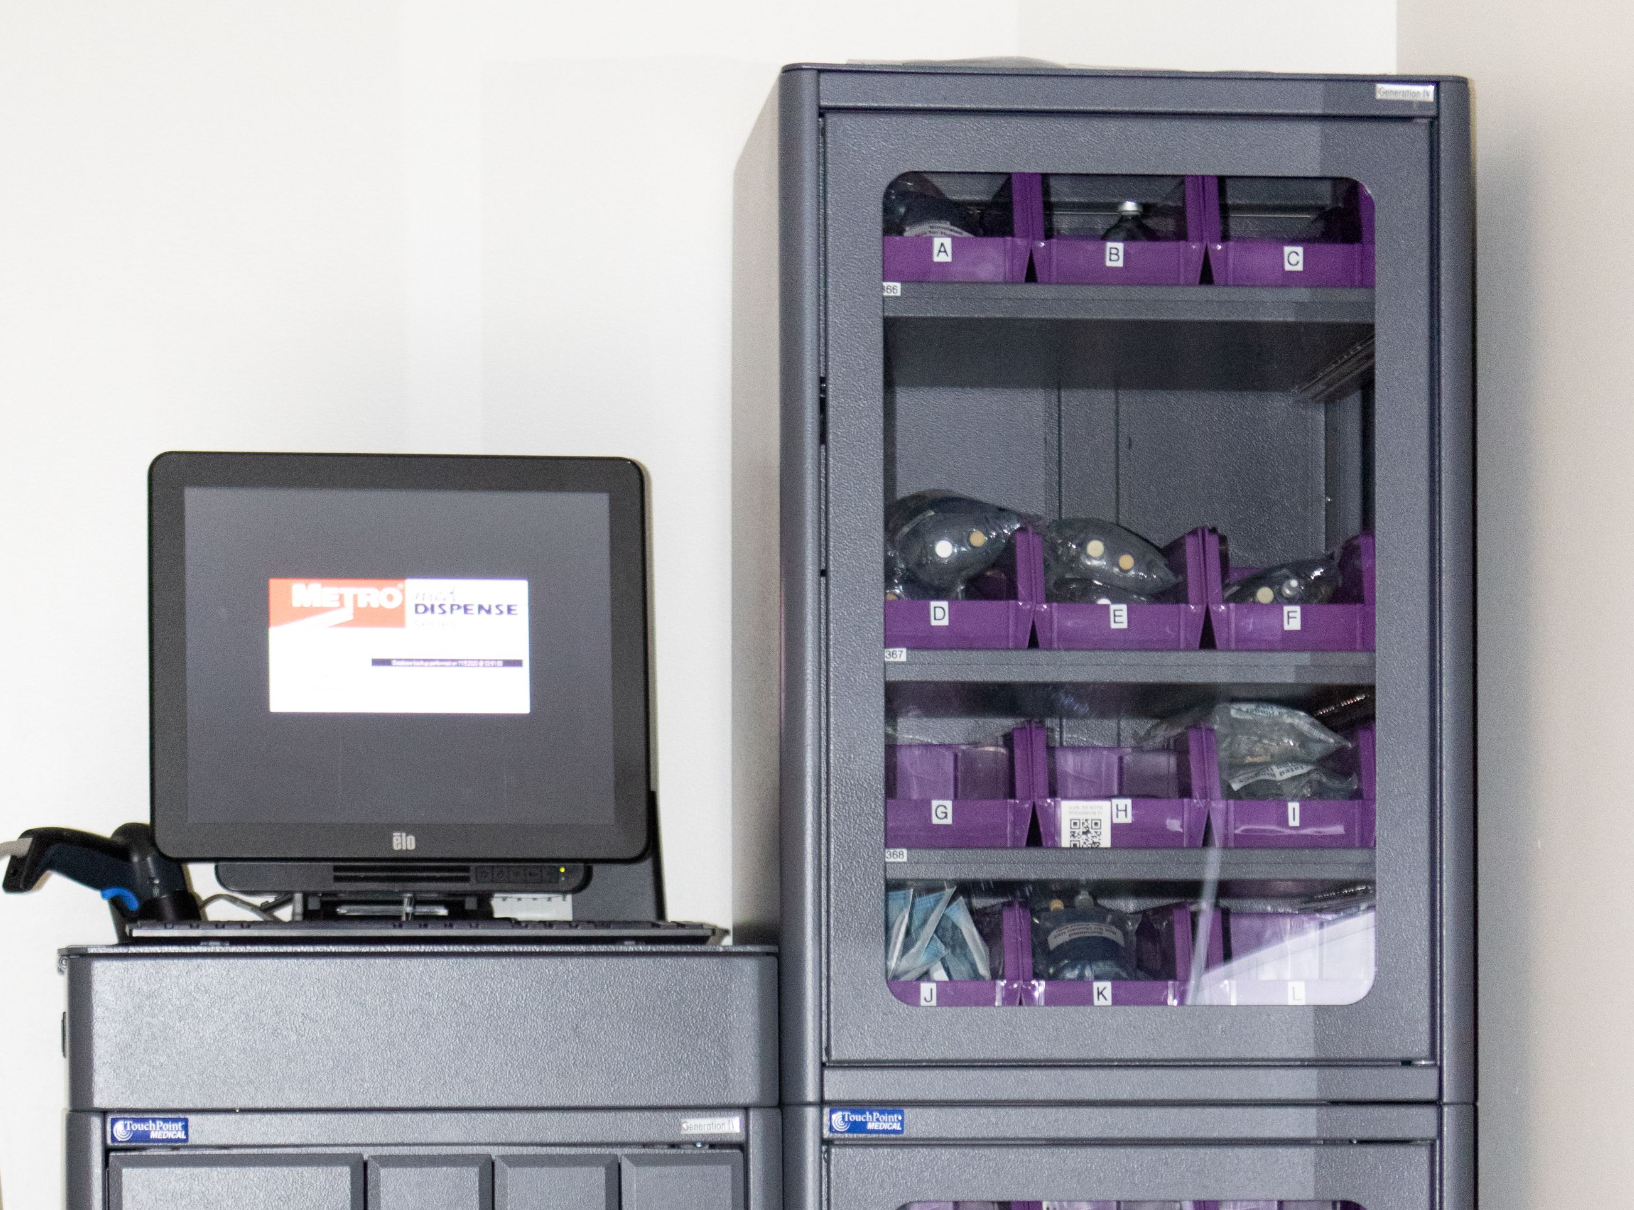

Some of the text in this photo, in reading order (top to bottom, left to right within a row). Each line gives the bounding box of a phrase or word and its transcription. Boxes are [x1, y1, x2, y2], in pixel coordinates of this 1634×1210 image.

[1379, 87, 1421, 98] Generation
[936, 242, 949, 257] A
[1108, 246, 1120, 262] B
[1287, 250, 1300, 267] C
[414, 603, 518, 616] DISPENSE
[933, 606, 946, 621] D
[1113, 609, 1124, 624] E
[1286, 610, 1297, 626] F
[885, 650, 904, 659] 367
[934, 804, 948, 820] G
[1115, 804, 1128, 819] H
[1292, 807, 1296, 822] I
[885, 850, 905, 860] 368
[923, 987, 934, 1003] J
[1096, 986, 1108, 1002] K
[1292, 986, 1301, 1001] L
[842, 1111, 898, 1122] TouchPoint
[125, 1120, 183, 1131] TouchPoint
[682, 1121, 726, 1132] Generation
[867, 1122, 901, 1130] MEDICAL
[150, 1131, 186, 1139] MEDICAL
